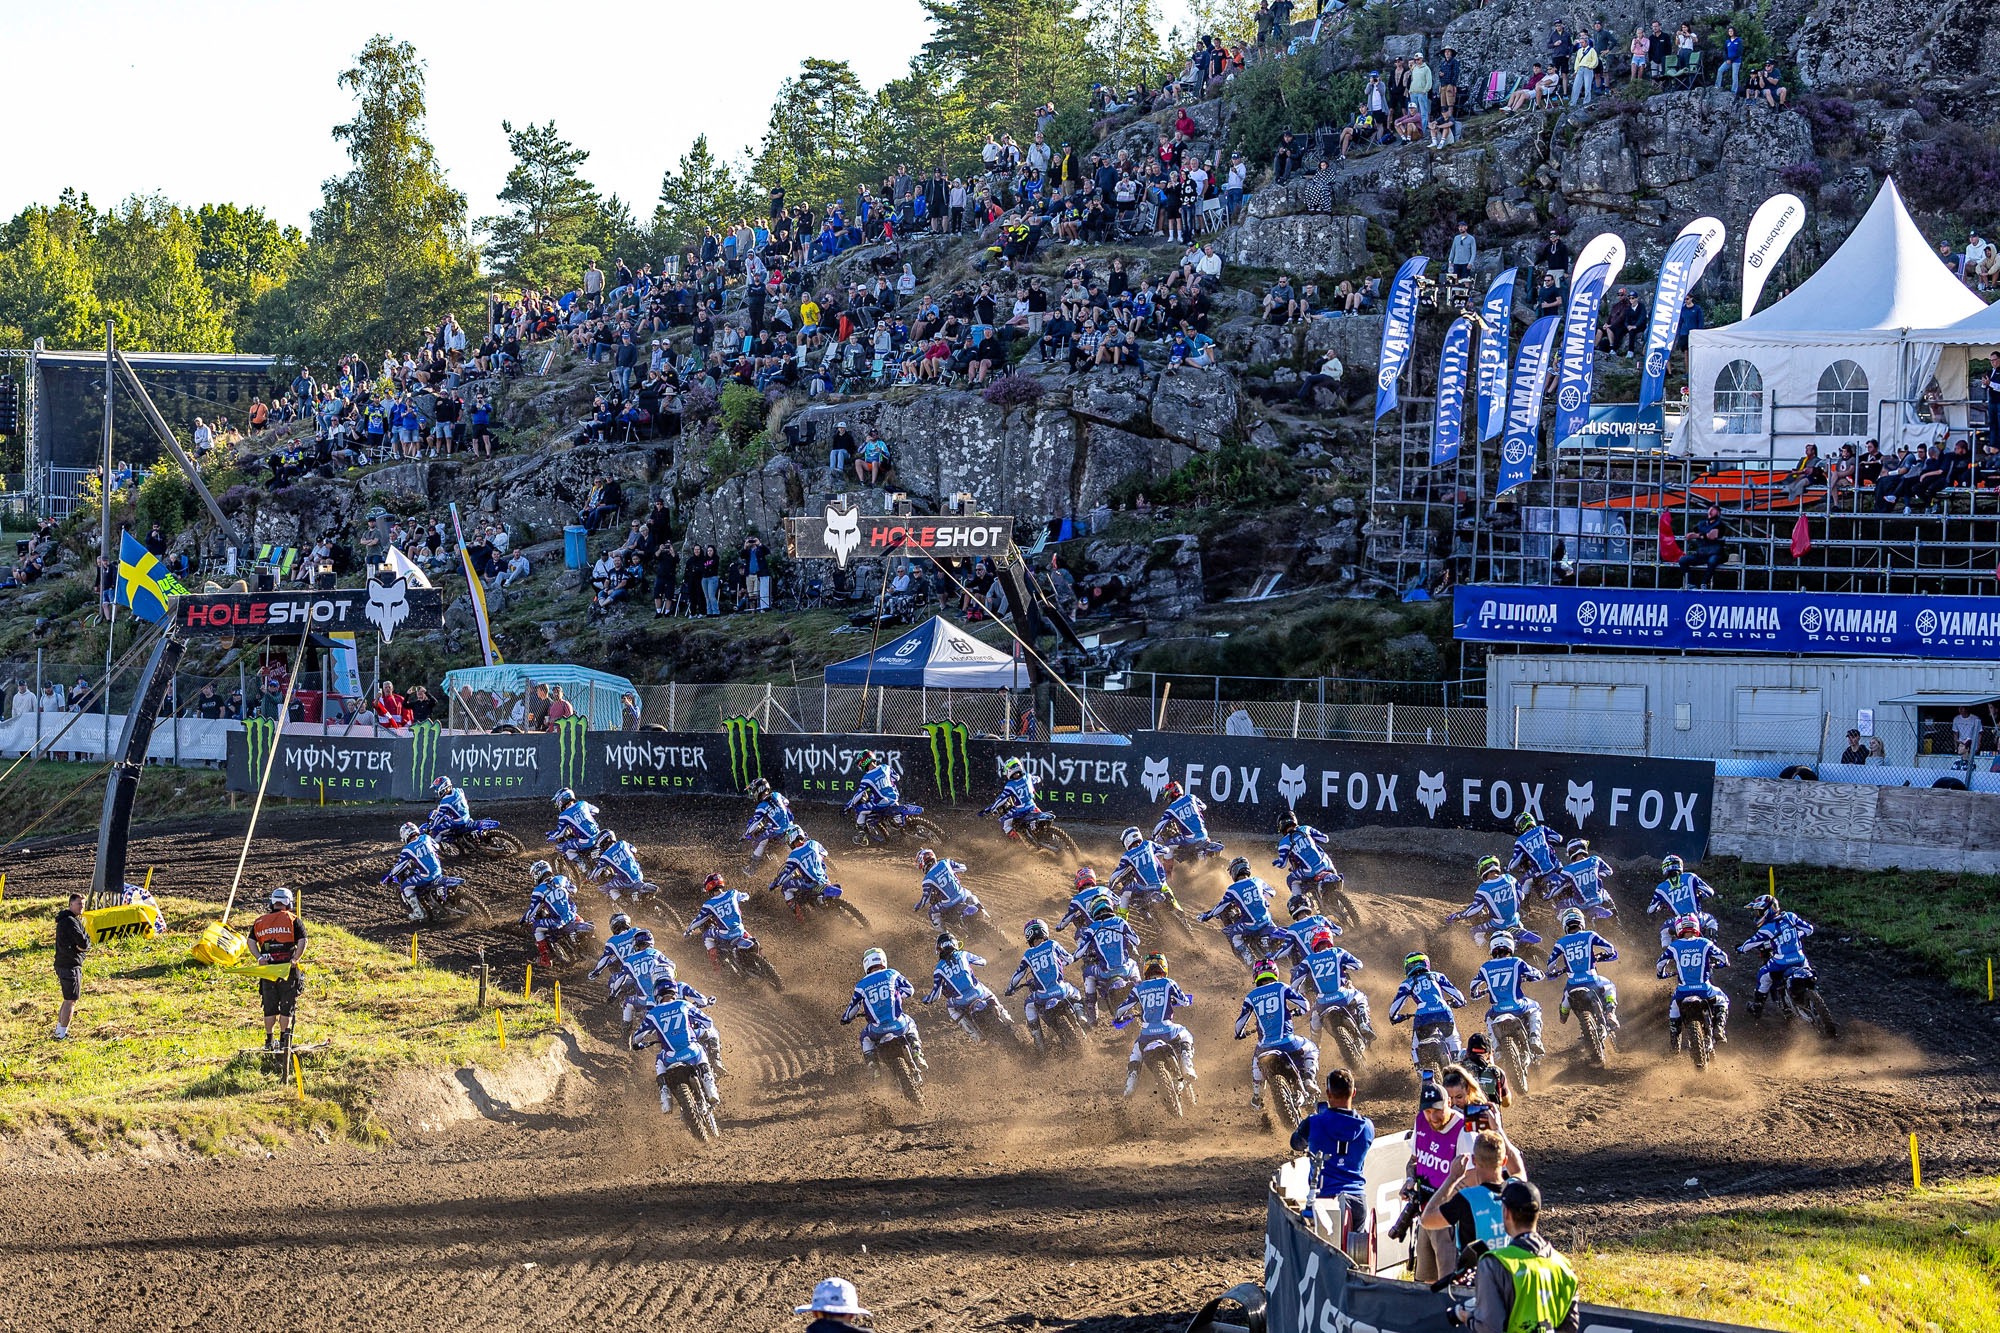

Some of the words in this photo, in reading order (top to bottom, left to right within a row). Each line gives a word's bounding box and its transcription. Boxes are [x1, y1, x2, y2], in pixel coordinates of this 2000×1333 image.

[1758, 204, 1796, 257] Husqvarna
[1650, 260, 1683, 351] YAMAHA
[1382, 279, 1413, 364] YAMAHA
[1562, 291, 1593, 384] YAMAHA
[1507, 343, 1542, 437] YAMAHA
[871, 526, 1003, 548] HOLESHOT
[187, 600, 352, 627] HOLESHOT
[1600, 602, 1669, 627] YAMAHA
[1709, 605, 1781, 631] YAMAHA
[1823, 608, 1897, 634] YAMAHA
[1583, 627, 1664, 637] RACING
[1692, 631, 1776, 640] RACING
[1809, 634, 1892, 643] RACING
[1922, 637, 2000, 646] RACIN
[285, 743, 394, 773] MONSTER
[450, 743, 538, 773] MONSTER
[605, 740, 708, 771] MONSTER
[300, 776, 378, 789] ENERGY
[462, 776, 524, 787] ENERGY
[621, 775, 695, 788] ENERGY
[803, 779, 854, 791] ENER
[1185, 763, 1260, 804] FOX
[1321, 770, 1399, 812] FOX
[1034, 791, 1109, 804] NERGY
[1462, 778, 1545, 822] FOX
[1609, 787, 1699, 832] FOX
[716, 902, 733, 920] 53
[1567, 946, 1589, 962] 551
[1680, 953, 1702, 968] 66
[1314, 961, 1336, 979] 22
[1490, 971, 1512, 987] 17
[868, 986, 891, 1005] 56
[1255, 996, 1280, 1017] 19
[660, 1014, 683, 1033] 77
[1430, 1141, 1440, 1153] 52
